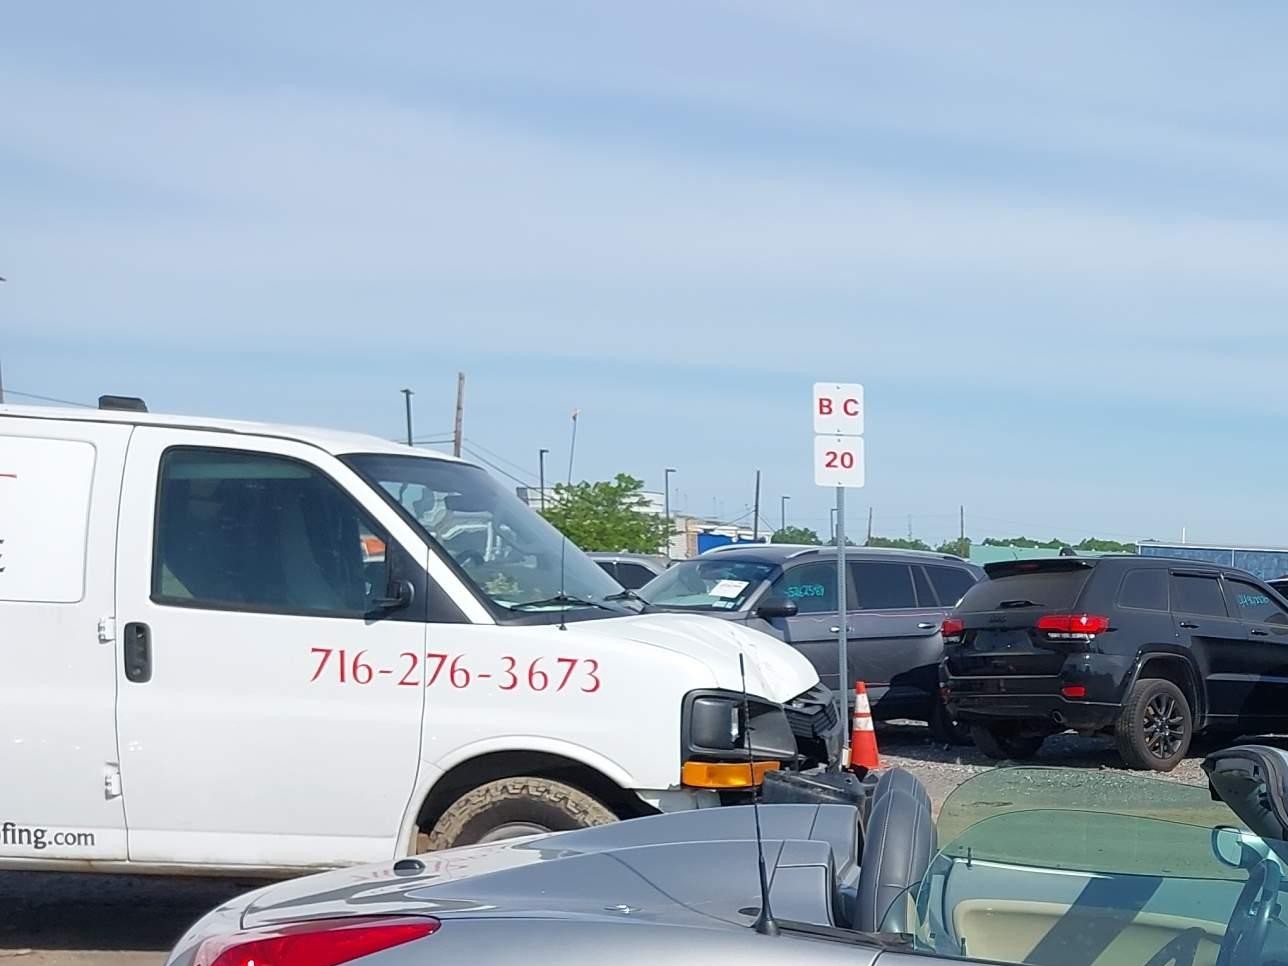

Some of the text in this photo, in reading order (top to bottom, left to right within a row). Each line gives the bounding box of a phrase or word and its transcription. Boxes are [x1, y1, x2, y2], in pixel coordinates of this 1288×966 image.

[818, 398, 860, 416] B C
[825, 451, 854, 469] 20
[310, 647, 601, 693] 716-276-3673
[0, 822, 95, 849] fing.com
